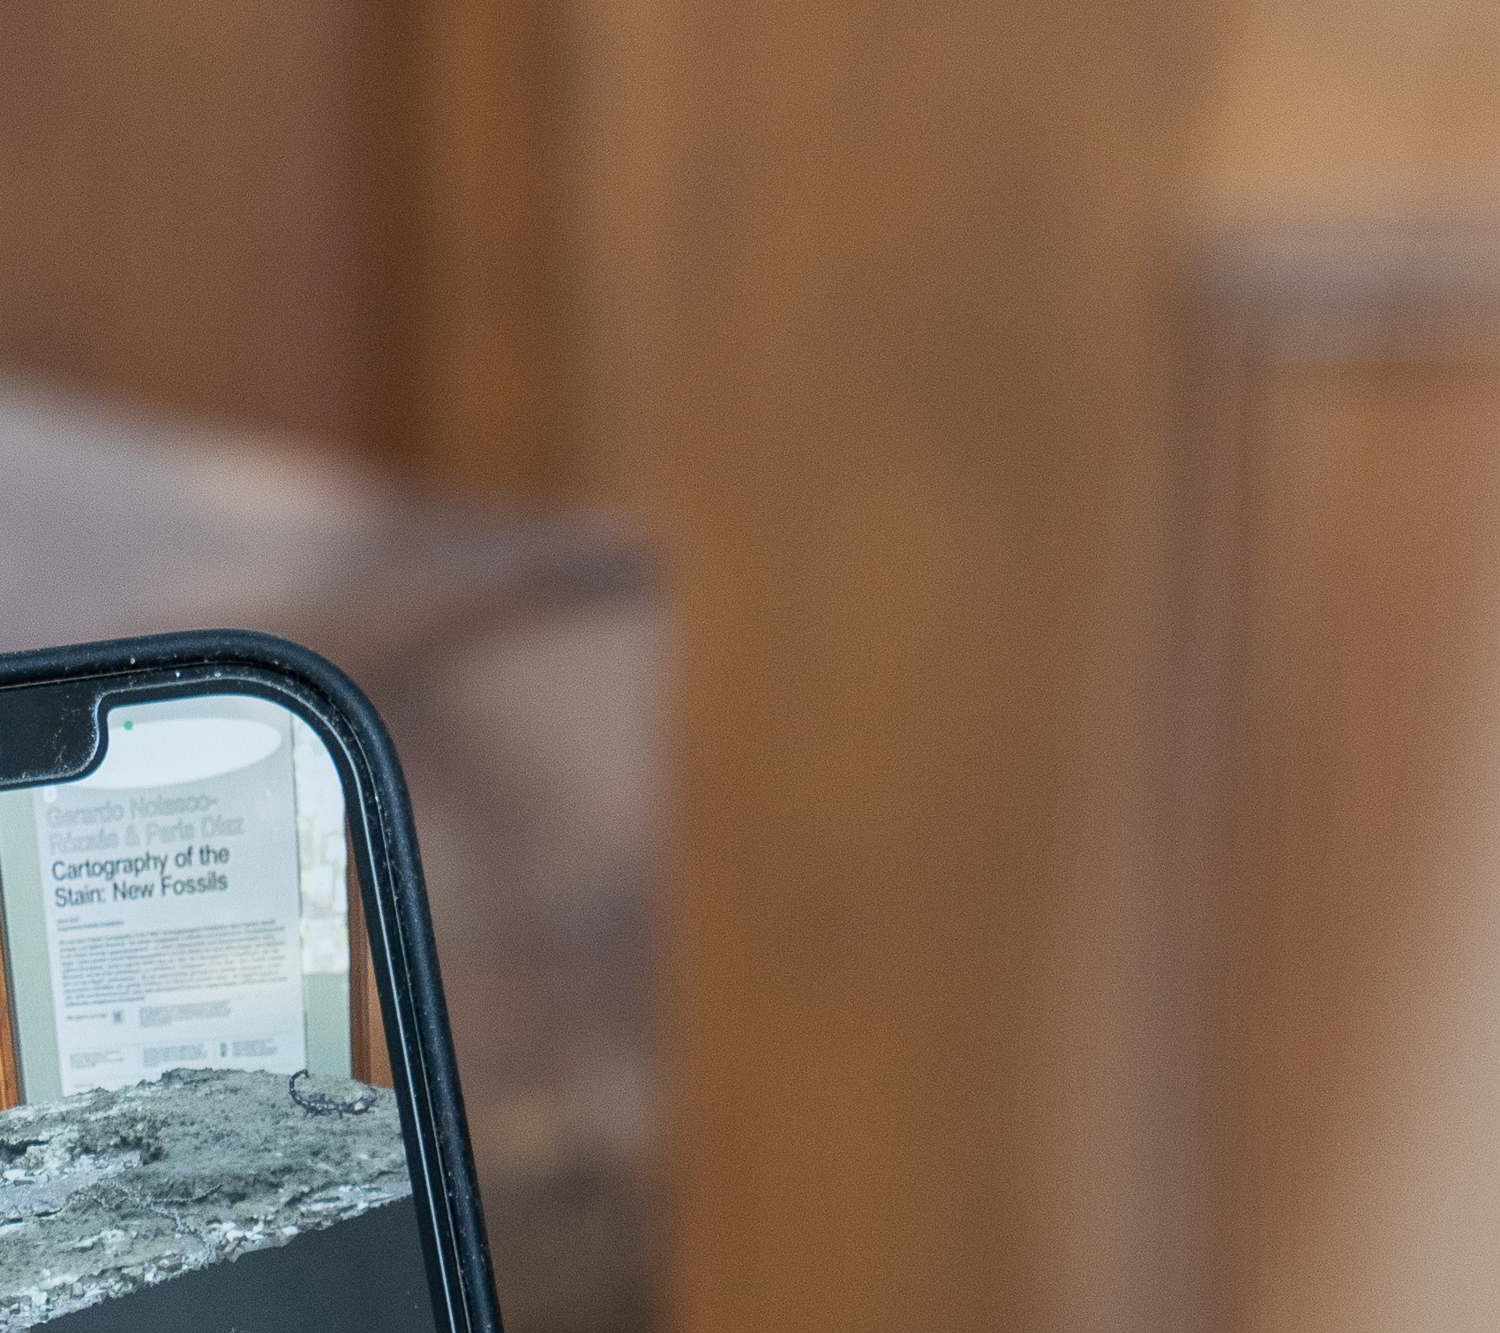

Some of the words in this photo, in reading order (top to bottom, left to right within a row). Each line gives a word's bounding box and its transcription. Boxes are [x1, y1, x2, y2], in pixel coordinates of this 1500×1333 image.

[52, 851, 168, 881] Cartography
[175, 845, 193, 868] of
[199, 845, 229, 866] the
[55, 885, 106, 908] Stain:
[113, 881, 154, 901] New
[161, 871, 228, 896] Fossils
